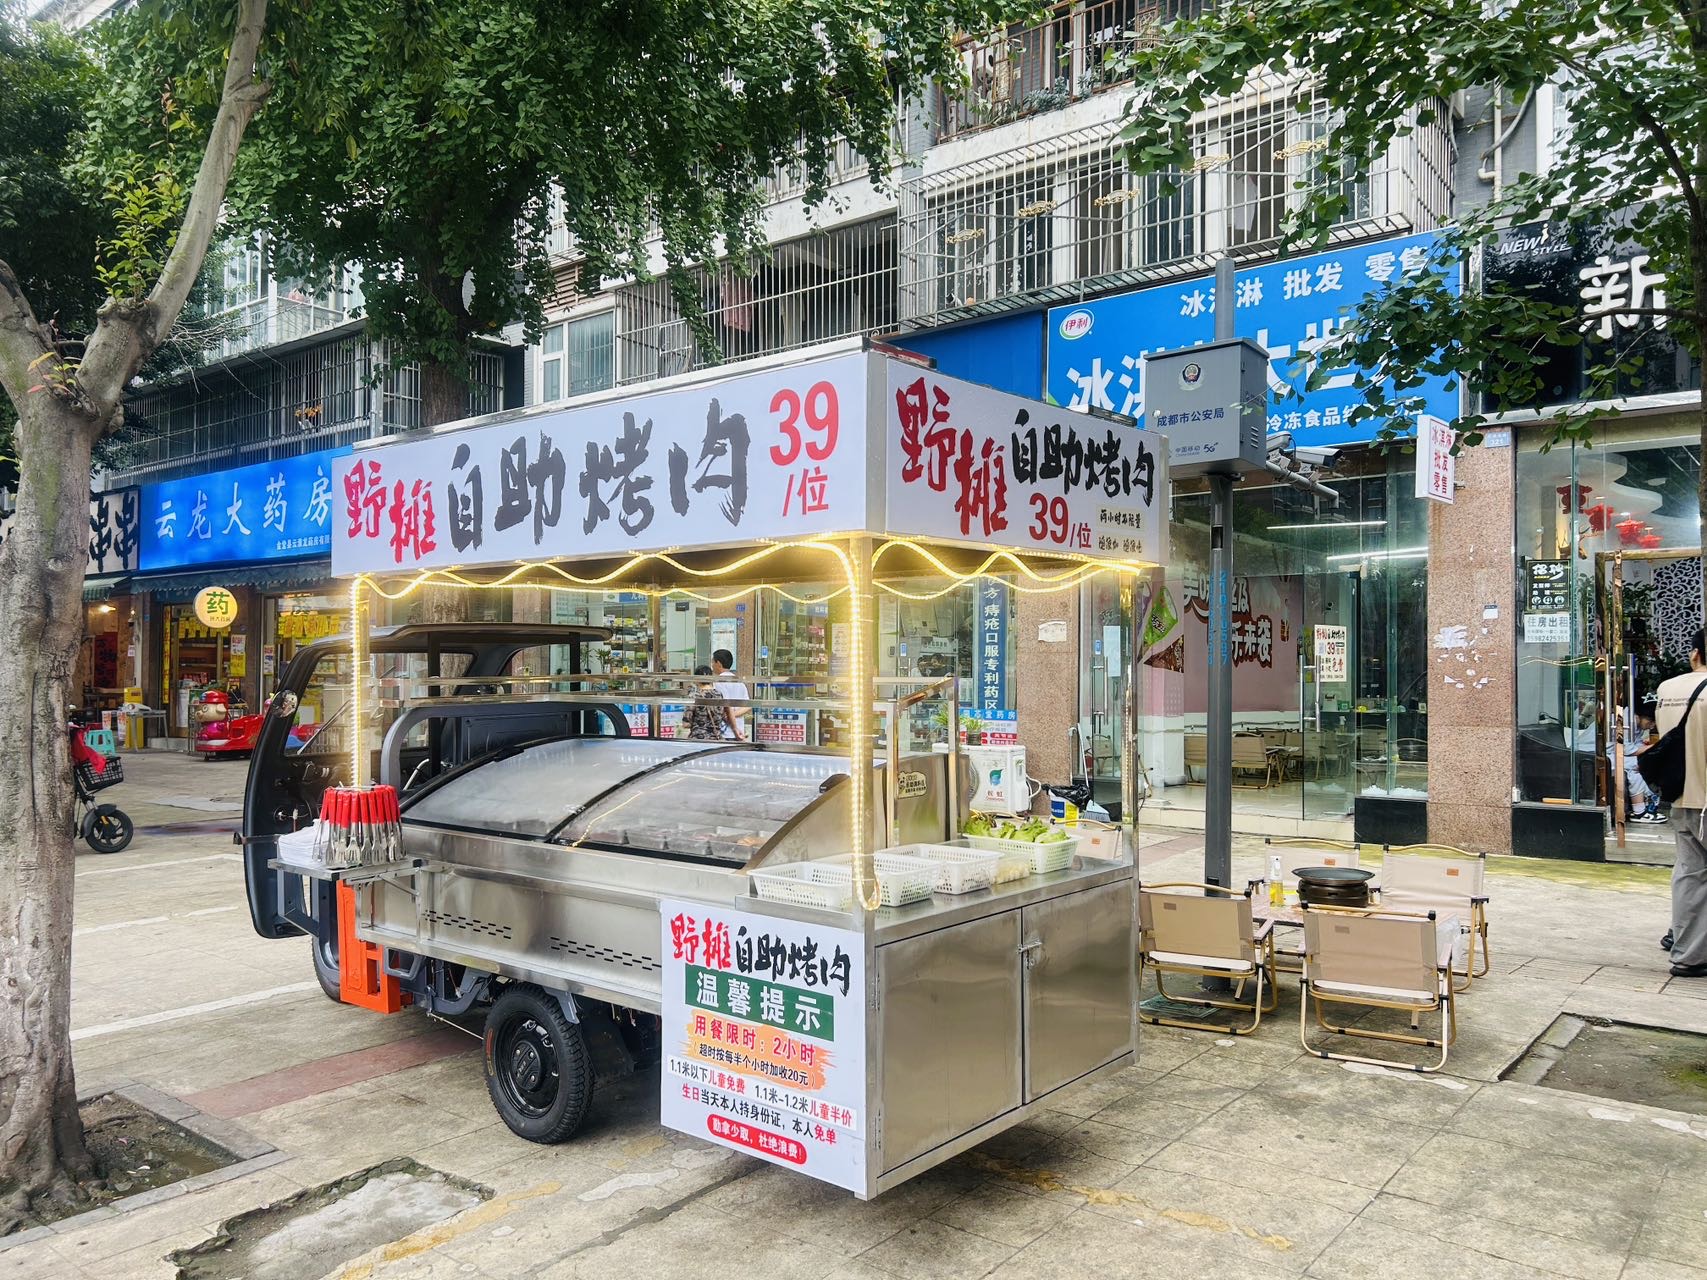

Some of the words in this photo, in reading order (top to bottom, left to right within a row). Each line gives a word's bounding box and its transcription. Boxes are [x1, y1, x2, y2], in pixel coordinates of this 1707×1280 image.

[1500, 236, 1541, 255] NEW
[1283, 260, 1343, 300] 批发
[1365, 245, 1429, 282] 零售
[1579, 255, 1668, 339] 新
[769, 380, 840, 468] 39
[1156, 407, 1225, 428] 成都市公安局
[1175, 445, 1201, 453] 中国移动
[154, 468, 333, 540] 云龙大药房
[782, 467, 830, 518] /位
[206, 591, 231, 615] 药
[696, 971, 821, 1031] 温馨提示
[670, 1058, 746, 1095] 1.1米以下儿童免费
